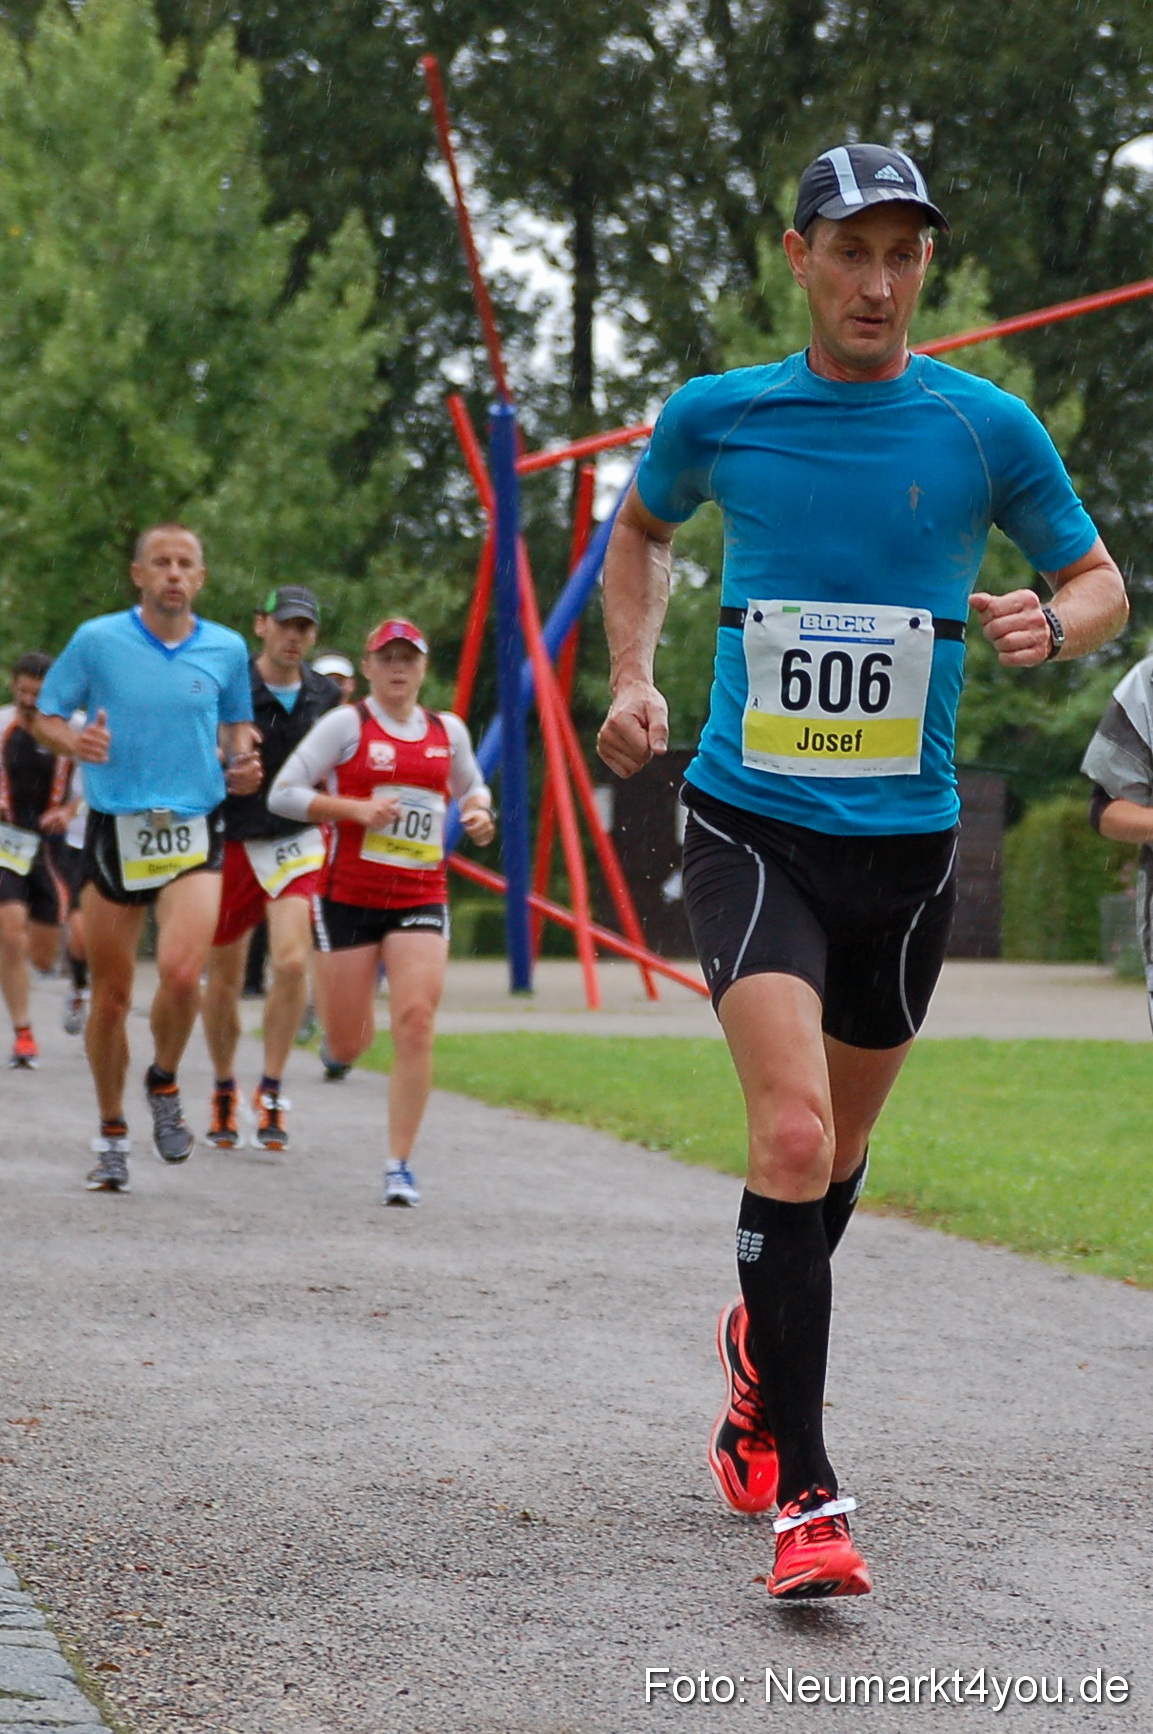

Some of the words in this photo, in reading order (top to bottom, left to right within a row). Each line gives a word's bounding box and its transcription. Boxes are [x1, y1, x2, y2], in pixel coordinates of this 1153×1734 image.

[800, 613, 876, 633] BOCK
[780, 648, 893, 715] 606
[796, 726, 863, 752] Josef
[137, 826, 191, 856] 208
